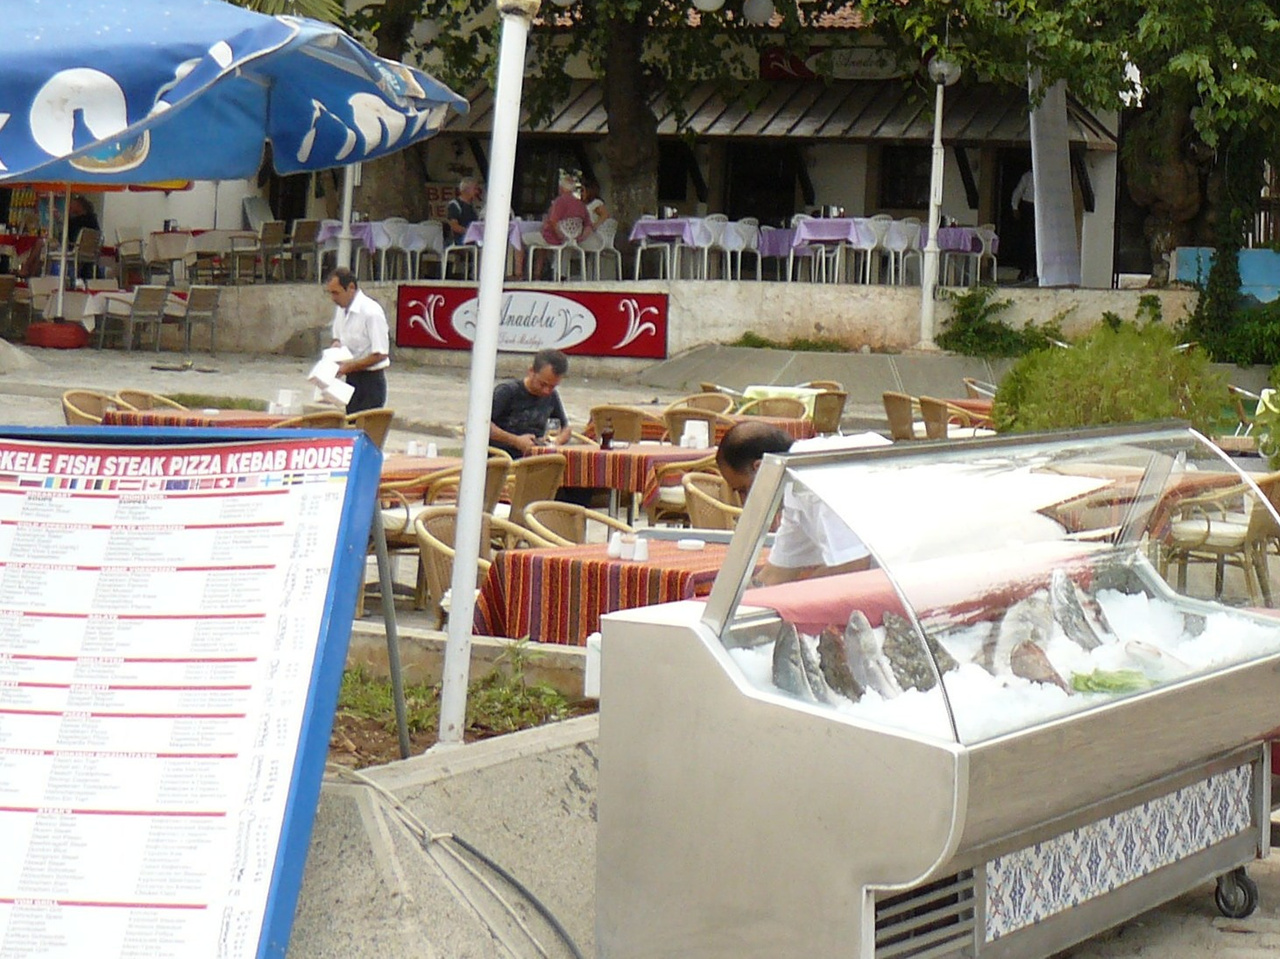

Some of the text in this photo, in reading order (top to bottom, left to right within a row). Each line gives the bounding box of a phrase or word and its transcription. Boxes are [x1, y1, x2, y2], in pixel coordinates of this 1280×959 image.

[498, 294, 557, 328] Anadolu
[54, 453, 102, 475] FISH
[103, 455, 167, 476] STEAK
[168, 454, 223, 476] PIZZA
[225, 449, 288, 474] KEBAB
[290, 446, 354, 470] HOUSE
